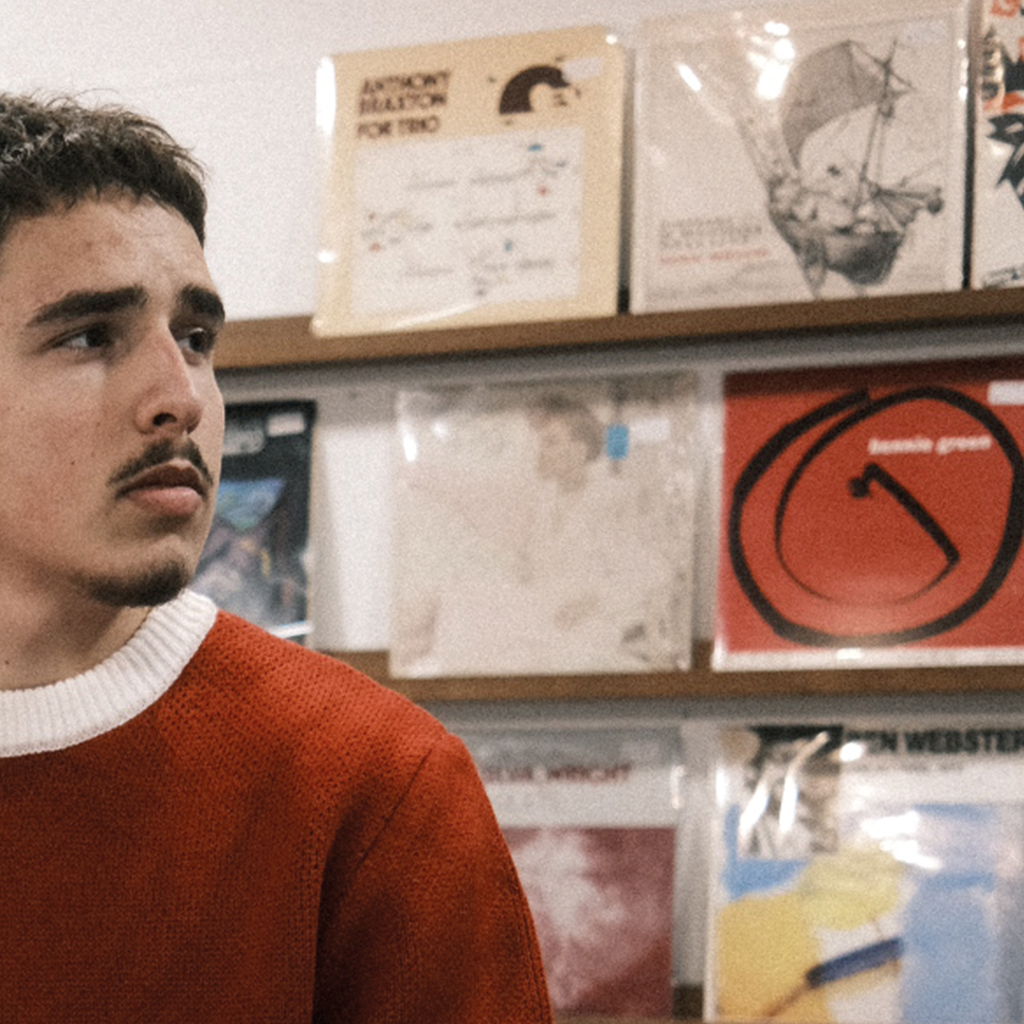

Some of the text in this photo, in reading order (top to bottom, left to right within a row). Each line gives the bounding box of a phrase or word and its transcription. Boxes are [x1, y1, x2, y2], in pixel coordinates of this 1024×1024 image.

[357, 115, 441, 139] FOR TRIO
[936, 434, 992, 455] green
